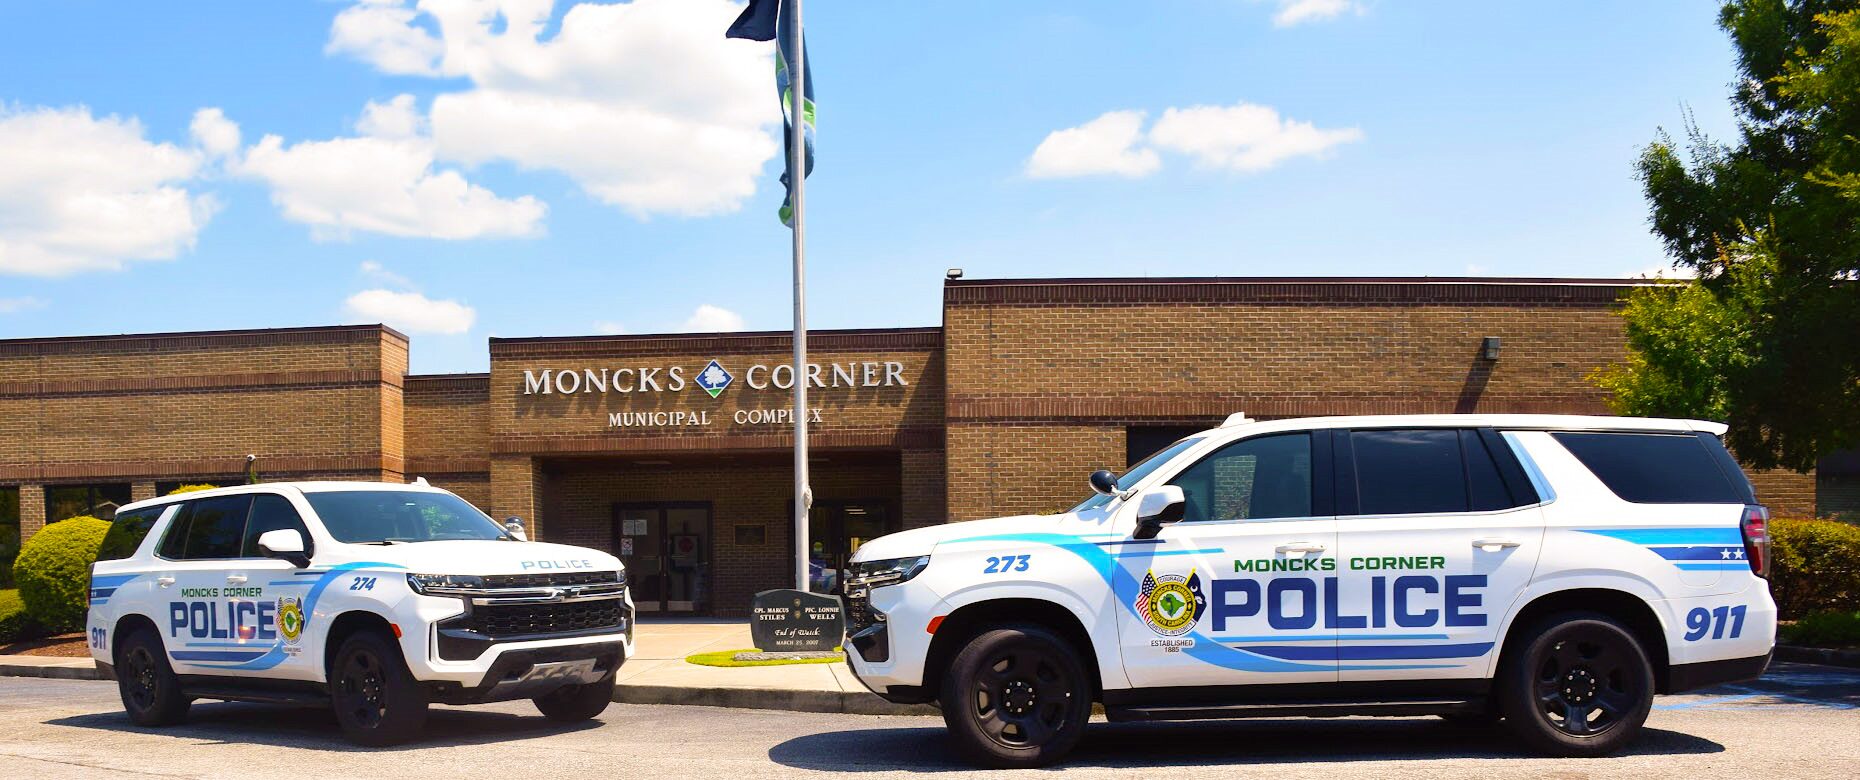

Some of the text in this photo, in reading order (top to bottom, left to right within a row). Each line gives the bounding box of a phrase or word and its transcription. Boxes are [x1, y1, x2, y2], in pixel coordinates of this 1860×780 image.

[523, 361, 909, 395] MONCKS CORNER
[608, 408, 823, 427] MUNICIPAL COMPLX
[521, 559, 593, 570] POLICE
[984, 554, 1031, 574] 273
[1234, 556, 1445, 572] MONCKS CORNER
[181, 587, 262, 598] MONCKS CORNER
[349, 576, 377, 591] 274
[1211, 574, 1488, 632] POLICE
[170, 601, 277, 639] POLICE
[1683, 605, 1747, 642] 911
[91, 627, 107, 650] 911
[789, 628, 798, 639] of
[1150, 639, 1193, 647] ESTABLISHED
